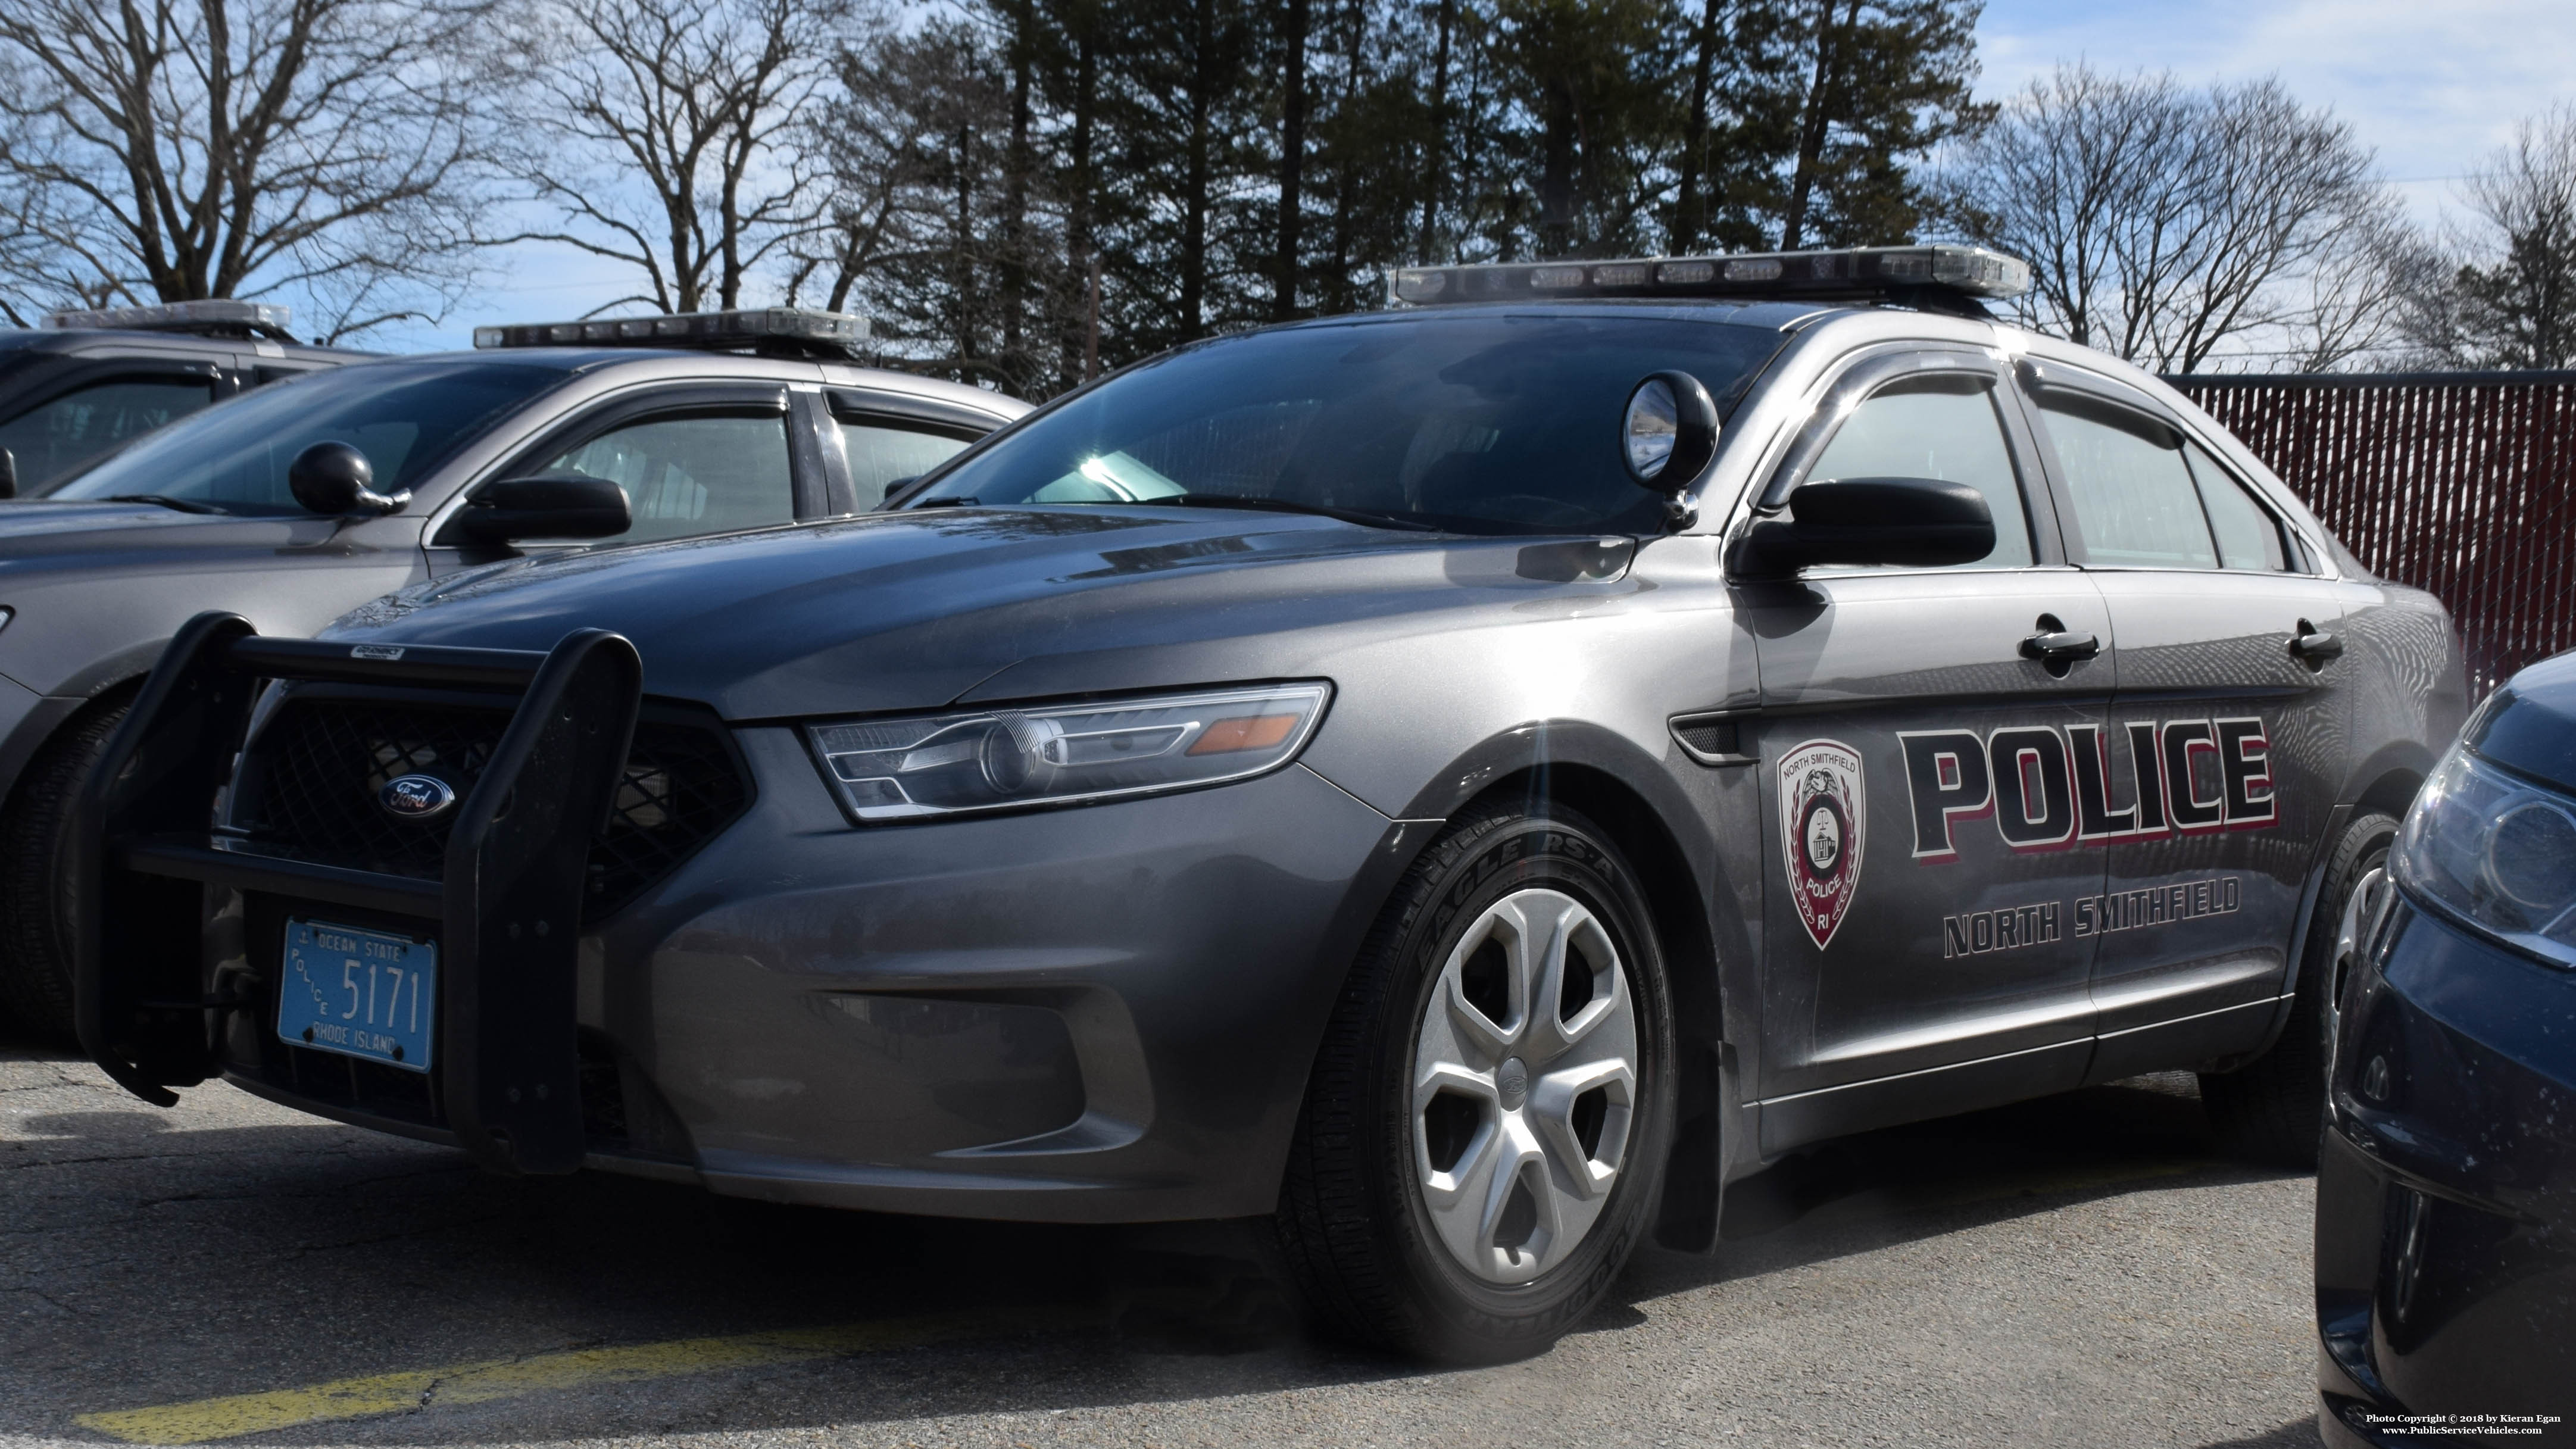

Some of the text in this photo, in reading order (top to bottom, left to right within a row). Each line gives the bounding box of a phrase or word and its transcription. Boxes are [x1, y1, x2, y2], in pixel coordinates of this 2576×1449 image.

[1784, 752, 1856, 780] NORTH SMITHFIELD
[391, 782, 431, 808] Ford
[1896, 716, 2279, 867] POLICE
[1806, 873, 1842, 898] POLICE
[1416, 838, 1522, 975] EAGLE
[1818, 913, 1829, 930] RI
[1943, 876, 2240, 959] NORTH SMITHFIELD
[318, 933, 401, 963] OCEAN STATE
[291, 948, 329, 1016] POLICE
[342, 958, 419, 1034] 5171
[313, 1021, 396, 1055] RHODE ISLAND
